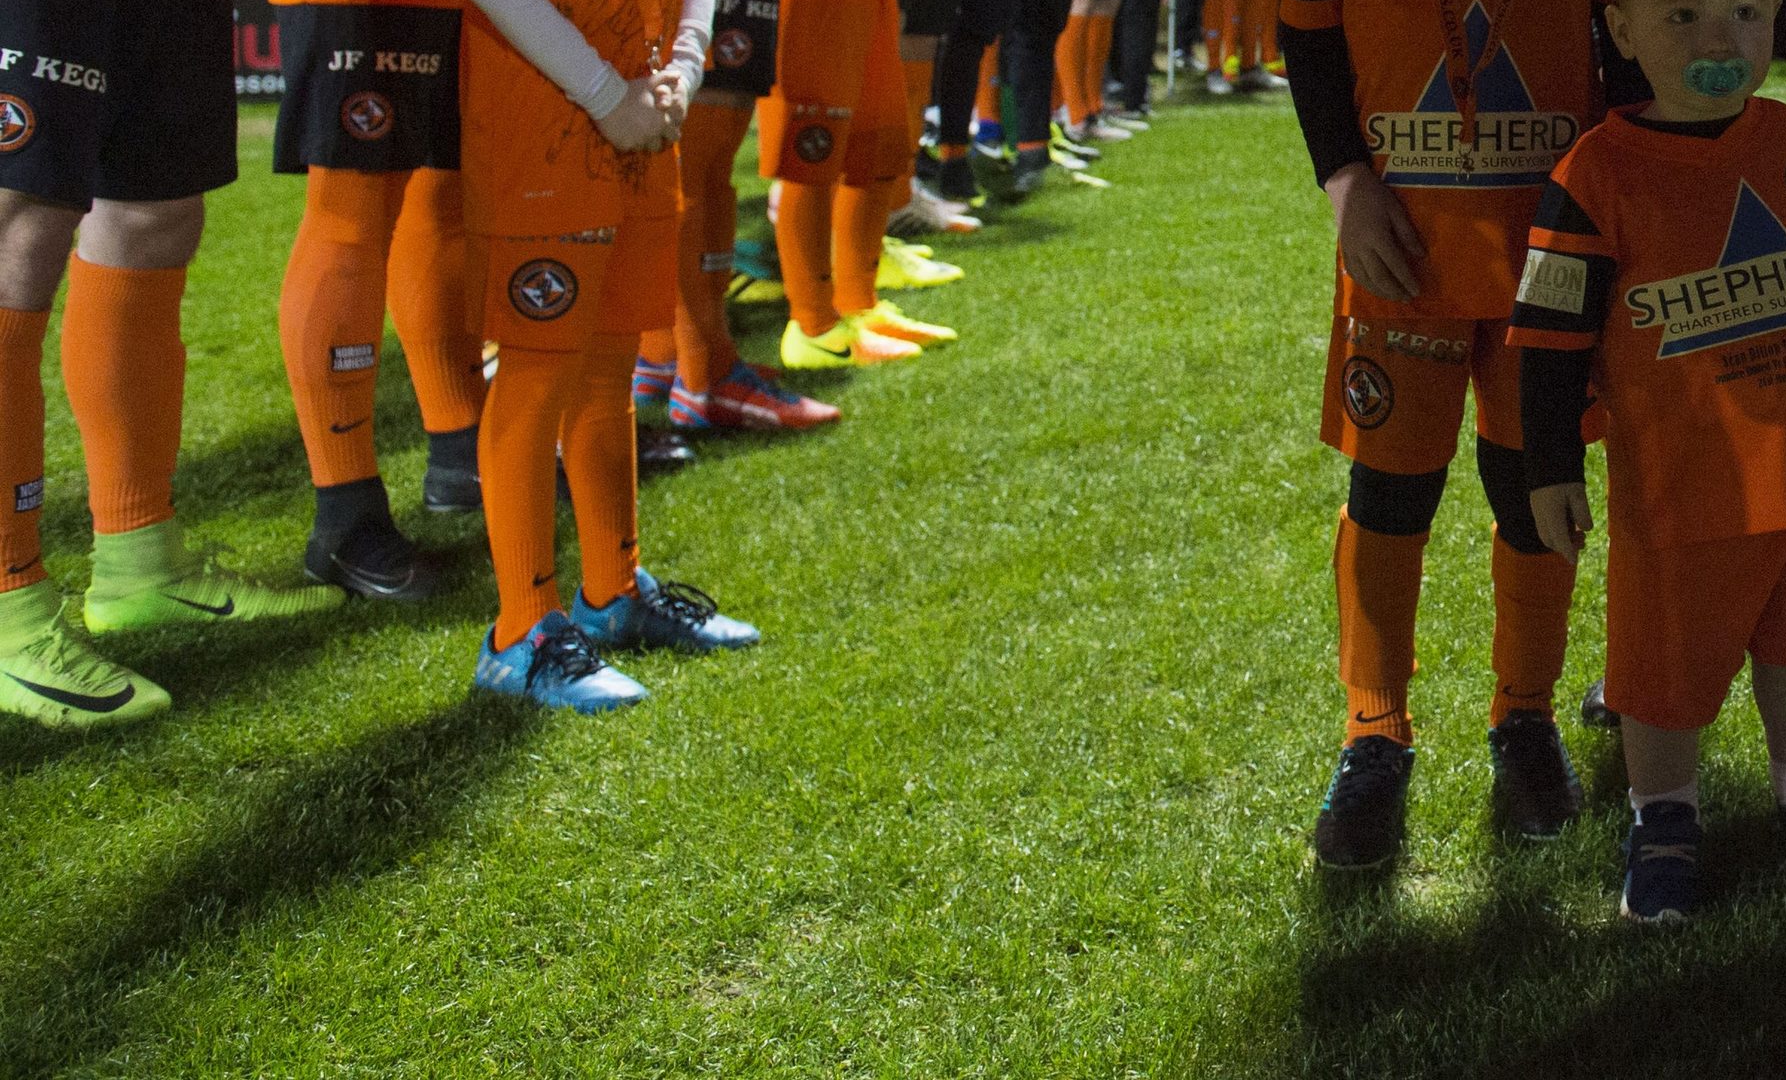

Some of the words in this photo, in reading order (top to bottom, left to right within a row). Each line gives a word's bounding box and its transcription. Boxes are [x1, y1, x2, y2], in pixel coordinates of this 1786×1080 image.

[0, 48, 23, 71] F
[328, 50, 364, 71] JF
[374, 51, 443, 75] KEGS
[1367, 113, 1578, 153] SHEPHERD
[1668, 301, 1764, 336] CHARTERED
